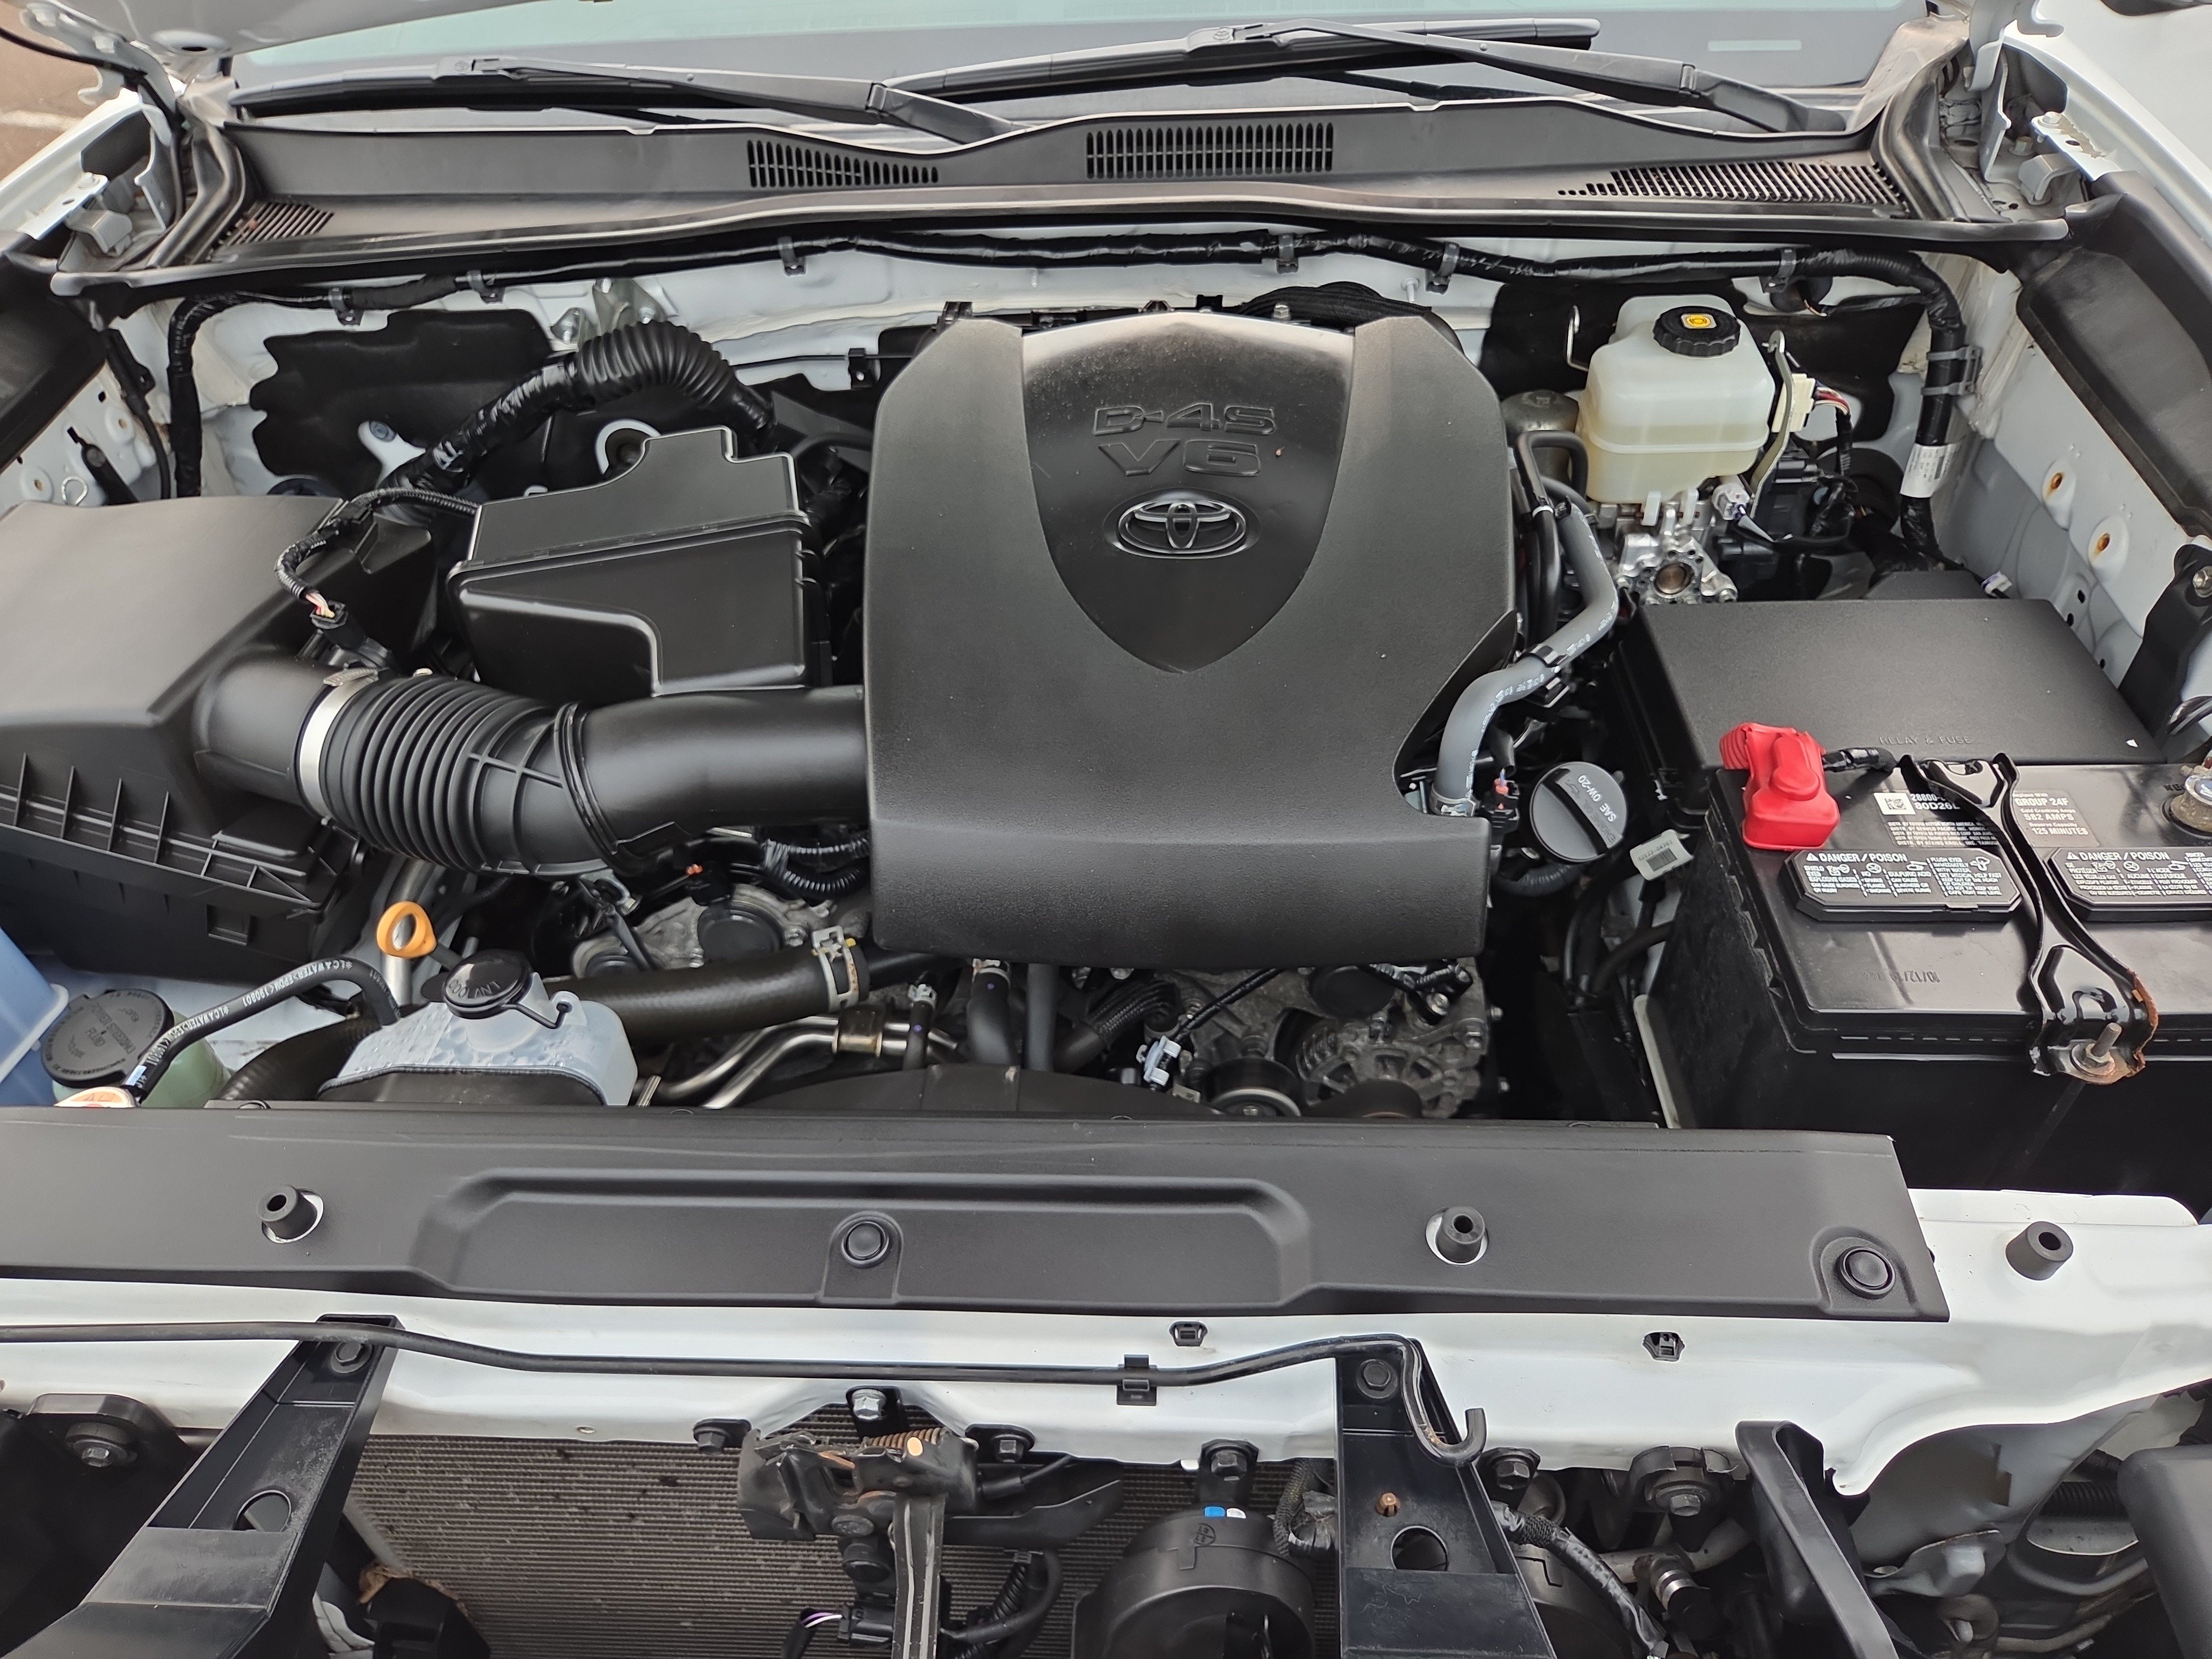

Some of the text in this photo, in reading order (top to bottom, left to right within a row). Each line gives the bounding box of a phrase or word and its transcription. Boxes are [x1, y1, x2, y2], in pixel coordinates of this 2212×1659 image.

[1093, 402, 1276, 436] D-4S
[1098, 439, 1261, 477] V6
[1879, 736, 1972, 744] RELAY & FUSE
[1578, 775, 1617, 822] SAE 0W-20
[2014, 798, 2068, 806] GROUP 24F
[448, 979, 500, 999] COOLANT
